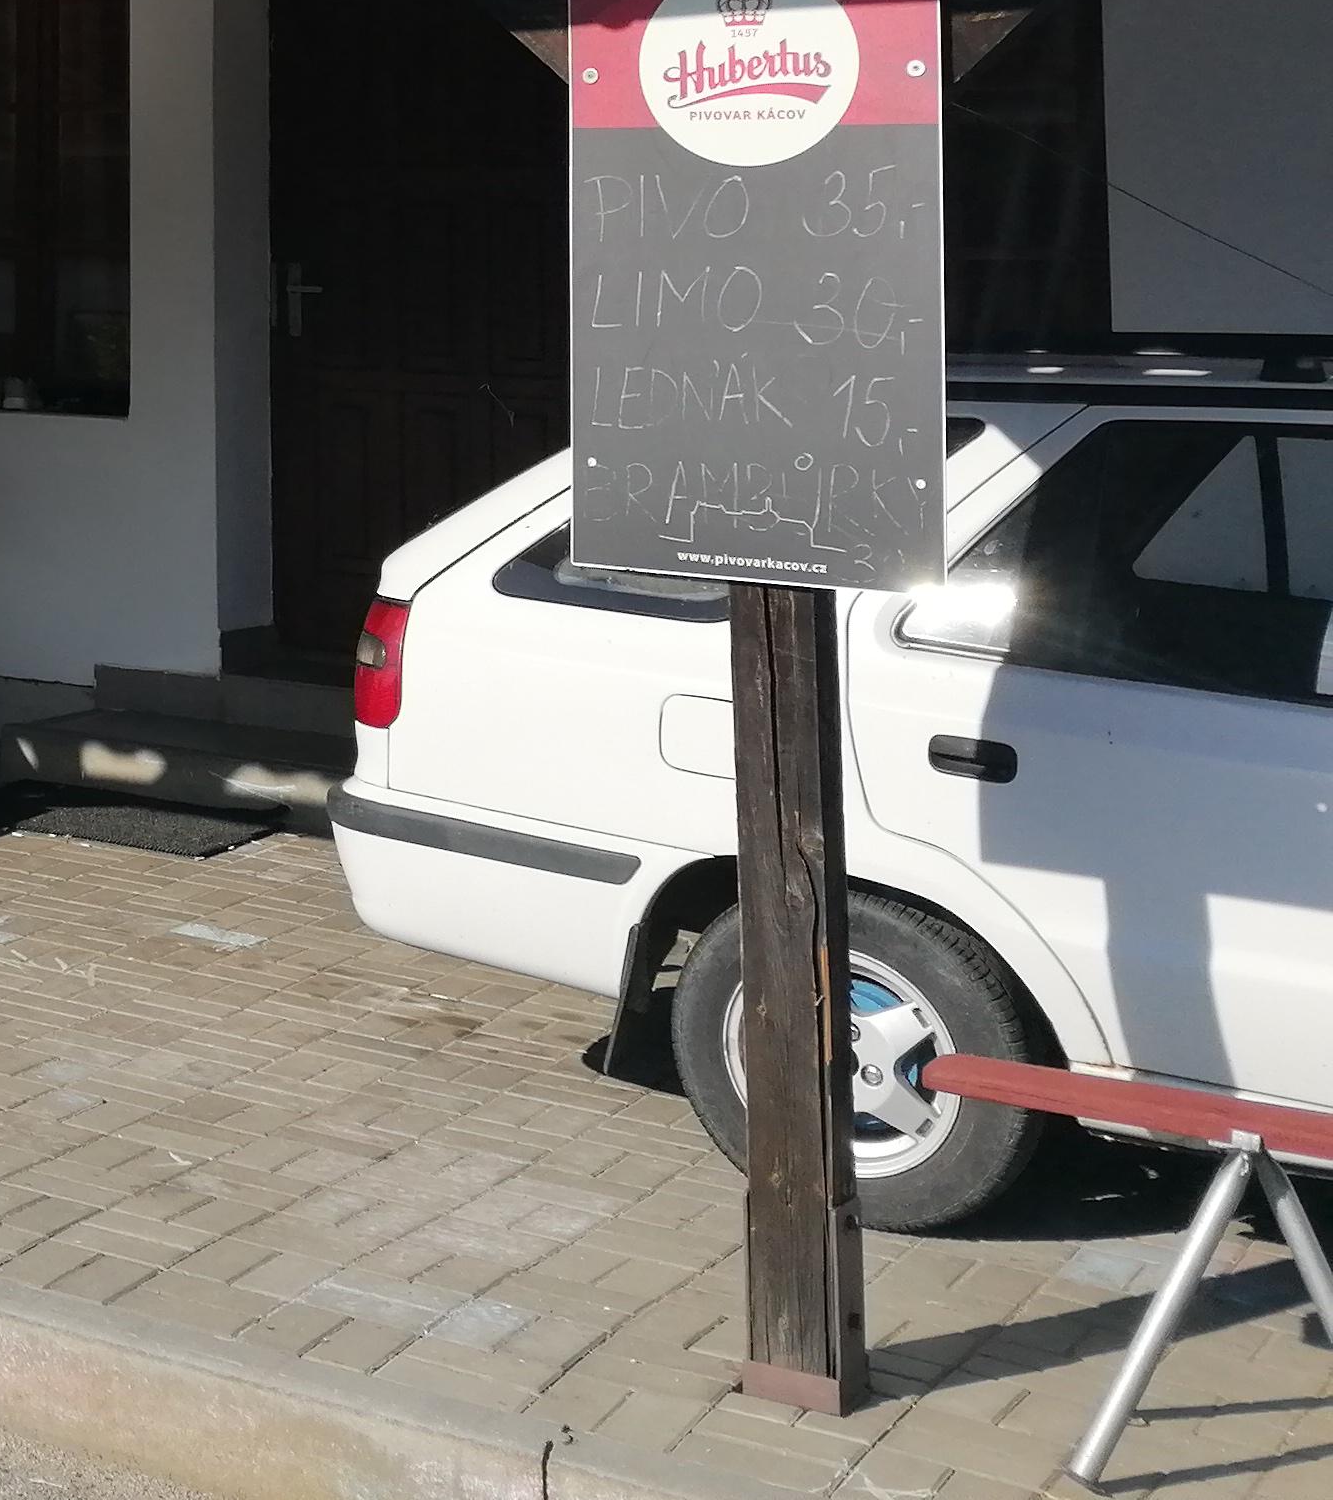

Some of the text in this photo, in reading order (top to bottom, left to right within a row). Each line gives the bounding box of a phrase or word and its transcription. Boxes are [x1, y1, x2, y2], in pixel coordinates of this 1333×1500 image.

[730, 28, 758, 38] 1457
[663, 38, 832, 100] Hubertus
[689, 107, 806, 122] PIVOVAR KÁCOV
[583, 174, 750, 242] PIVO
[591, 266, 763, 332] LIMO
[677, 551, 828, 575] www.pivovarkacov.cz
